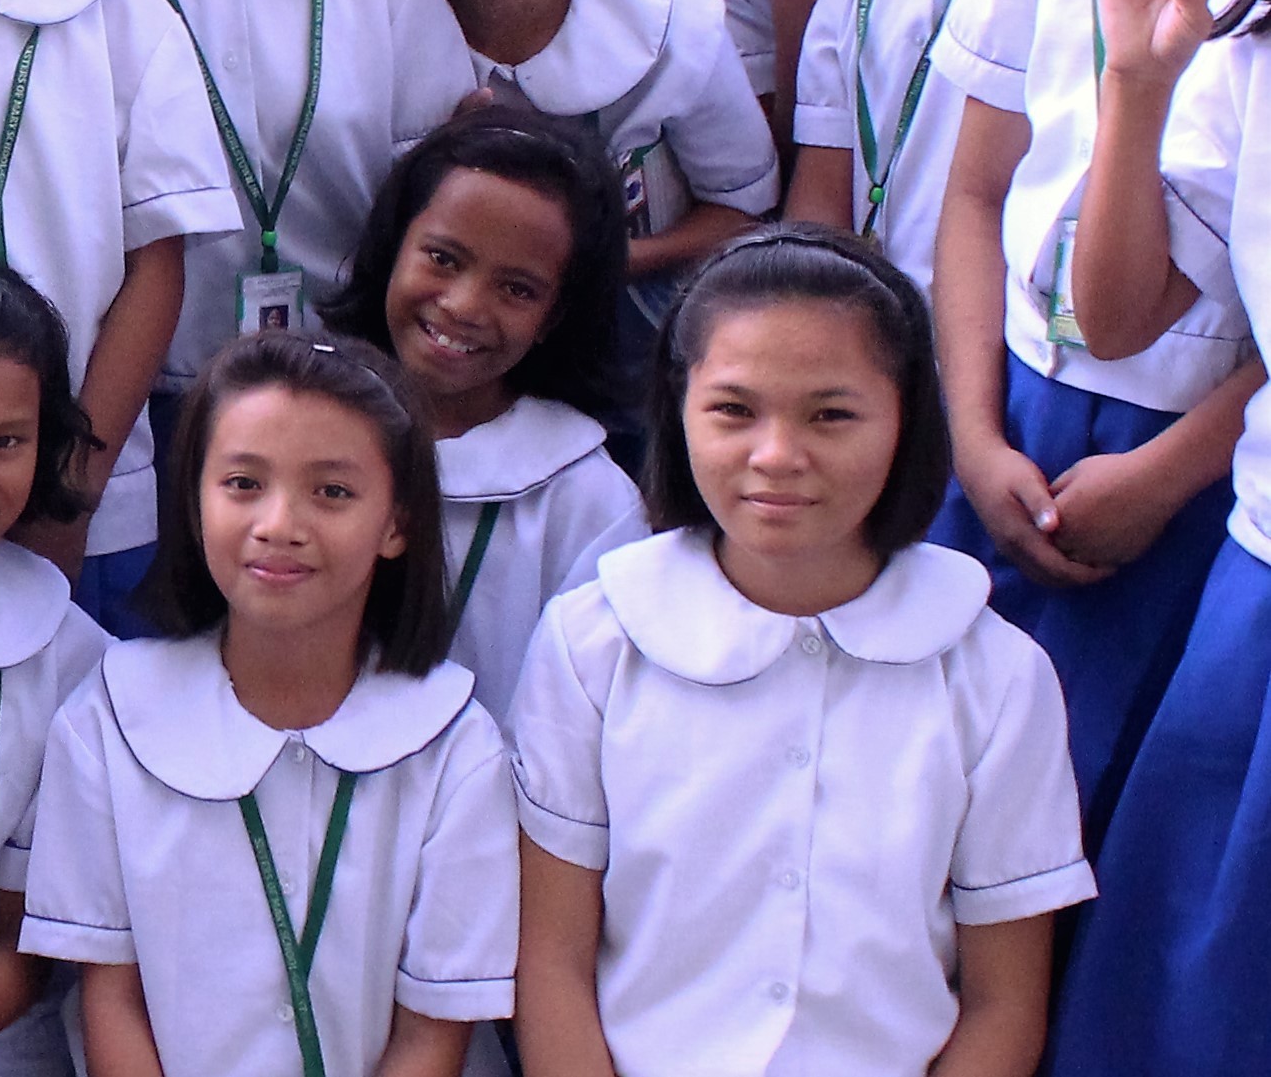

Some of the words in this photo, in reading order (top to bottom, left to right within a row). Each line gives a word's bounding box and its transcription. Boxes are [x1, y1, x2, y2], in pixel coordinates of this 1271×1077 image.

[16, 42, 36, 84] SISTERS
[13, 84, 25, 98] OF
[7, 98, 22, 129] MARY
